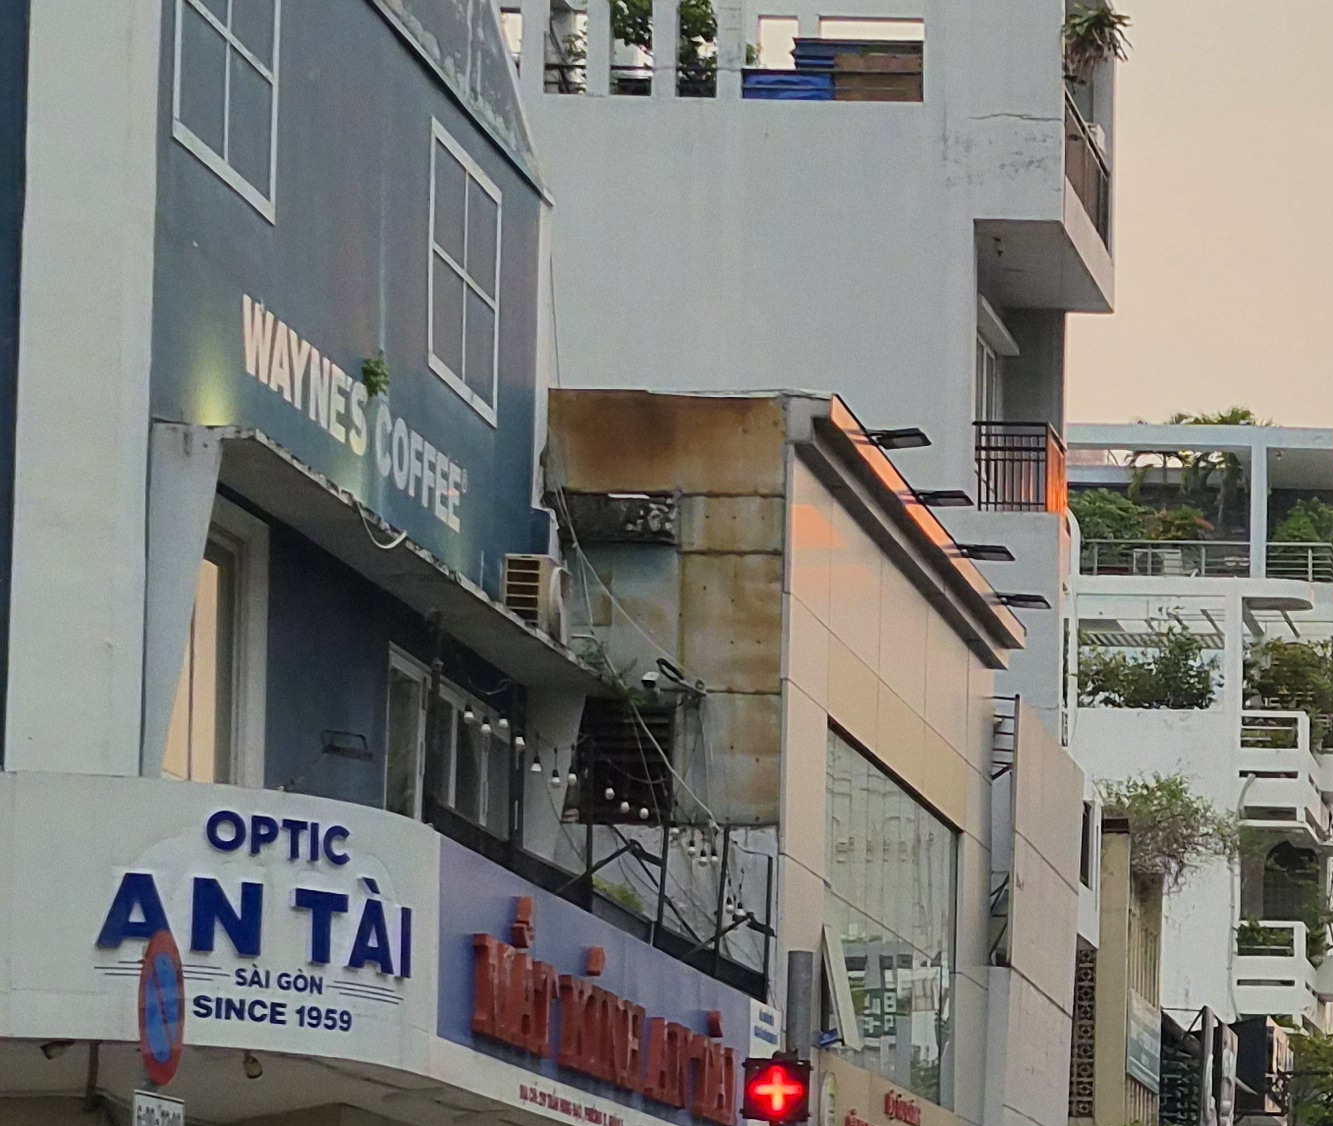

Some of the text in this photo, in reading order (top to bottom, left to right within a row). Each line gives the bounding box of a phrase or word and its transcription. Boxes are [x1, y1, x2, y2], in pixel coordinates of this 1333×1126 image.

[243, 293, 369, 456] WAYNE'S
[205, 809, 352, 867] OPTIC
[95, 871, 414, 980] AN TÀI
[234, 964, 325, 995] SÀI GÒN
[191, 993, 354, 1033] SINCE 1959
